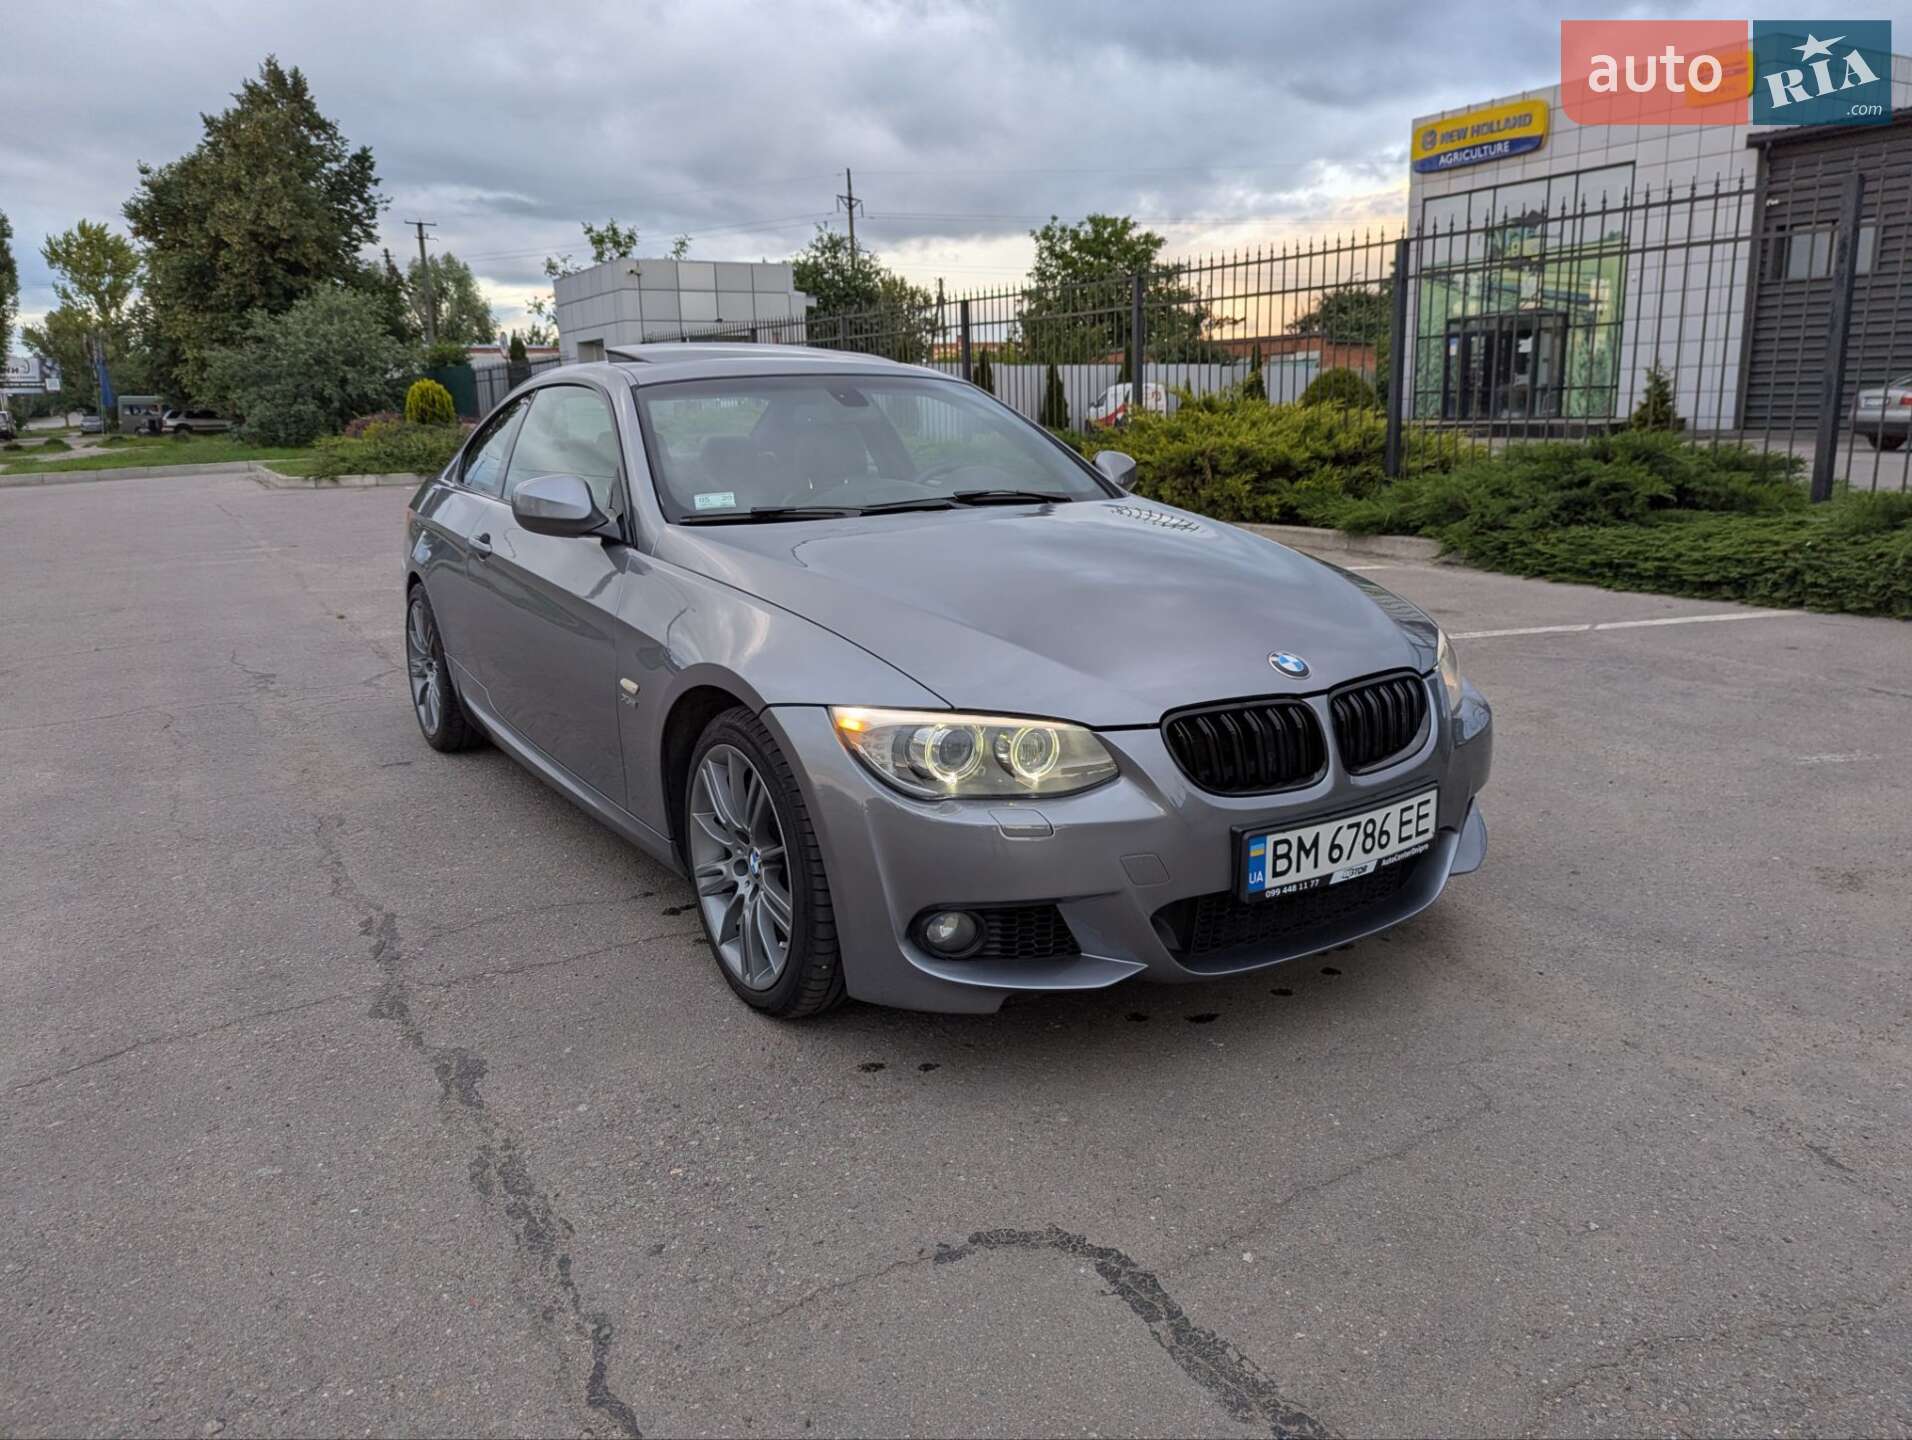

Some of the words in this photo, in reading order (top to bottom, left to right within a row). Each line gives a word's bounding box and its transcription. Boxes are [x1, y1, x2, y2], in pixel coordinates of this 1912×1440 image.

[1440, 126, 1469, 144] NEW
[1471, 113, 1533, 138] HOLLAND
[1439, 141, 1511, 166] AGRICULTURE
[1271, 831, 1320, 879] BM
[1327, 812, 1392, 864] 6786
[1398, 799, 1432, 844] EE
[1248, 870, 1264, 884] UA
[1265, 888, 1281, 898] 099
